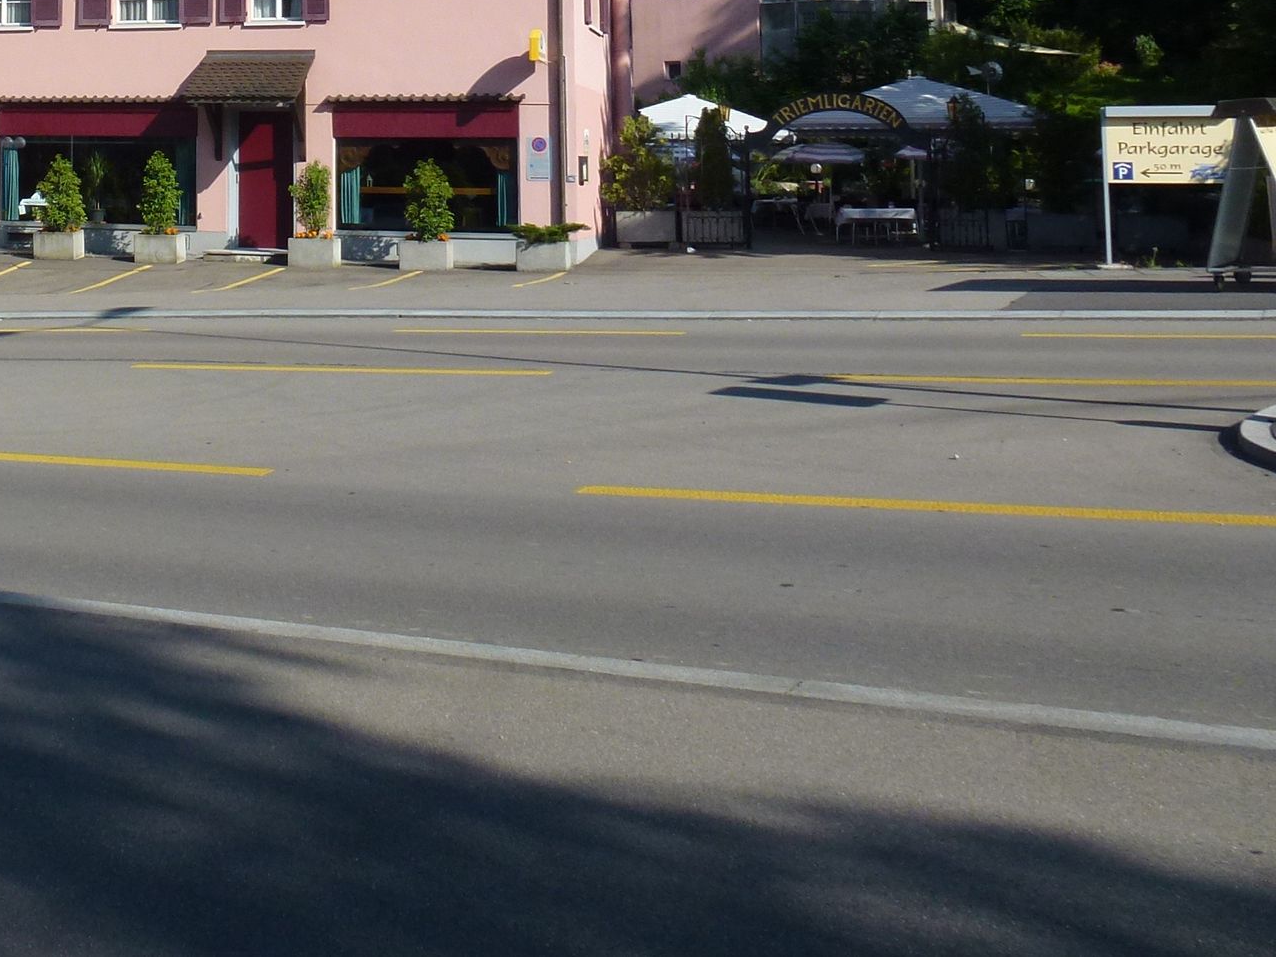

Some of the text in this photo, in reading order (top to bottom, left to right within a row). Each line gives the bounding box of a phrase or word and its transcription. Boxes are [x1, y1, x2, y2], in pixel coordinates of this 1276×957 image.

[772, 93, 903, 129] TRIEMLIGARTEN
[1132, 122, 1207, 138] Einfahrt
[1117, 141, 1223, 158] Parkgarage
[1153, 163, 1167, 171] 50
